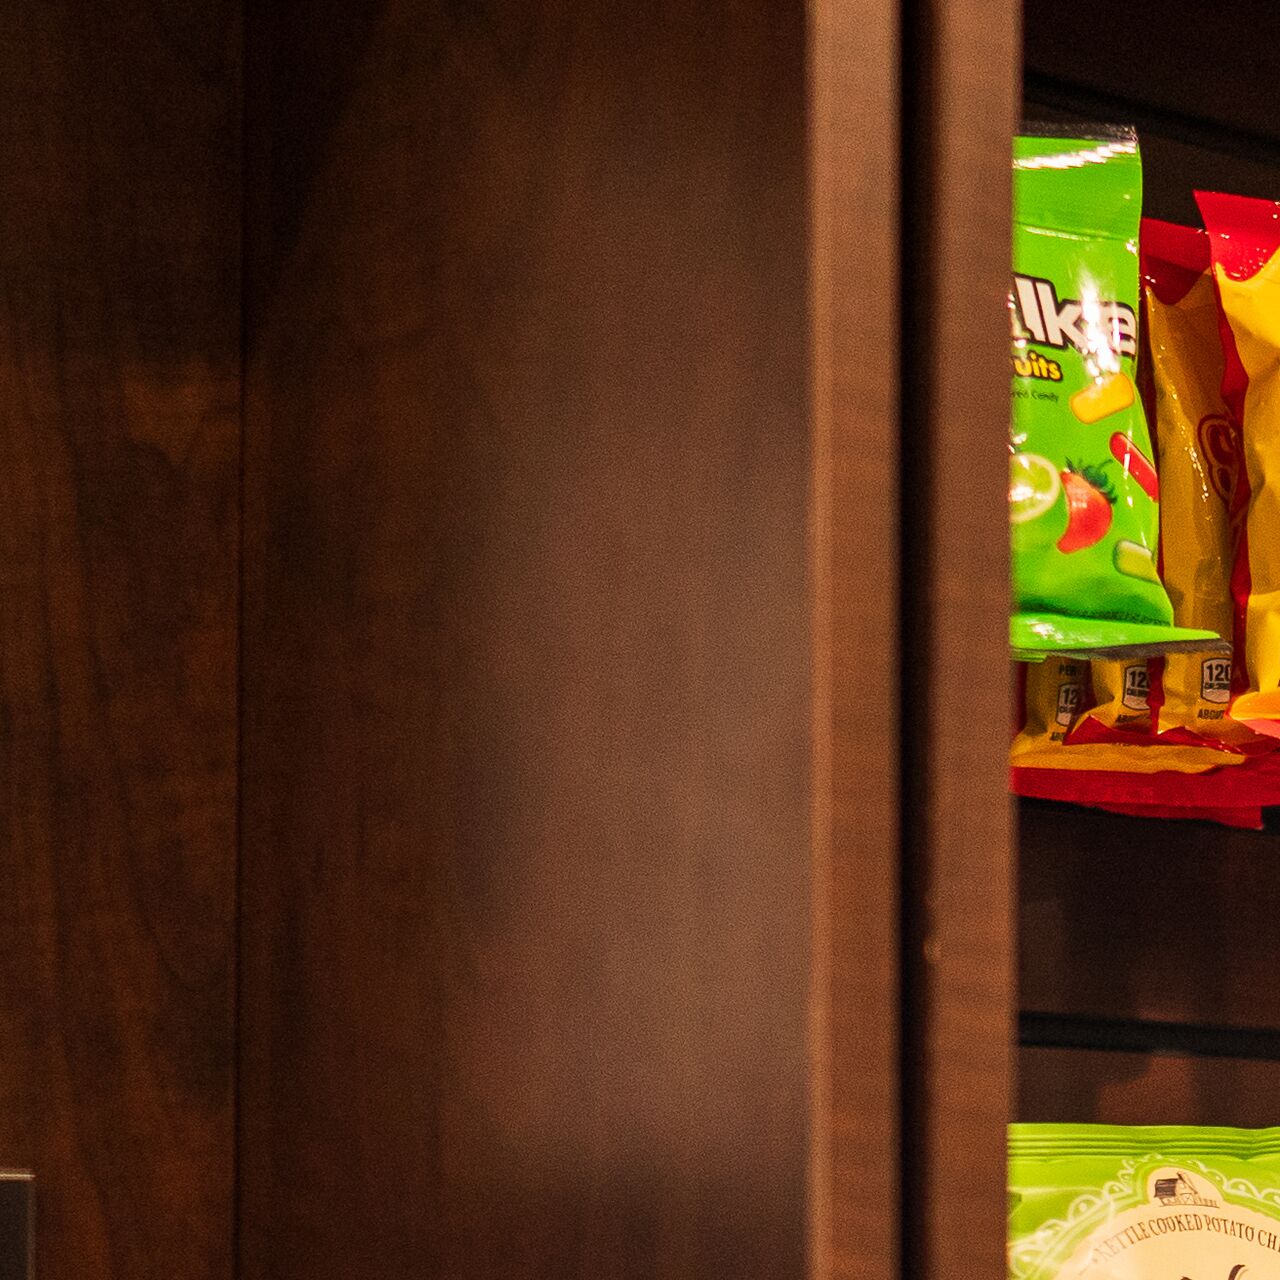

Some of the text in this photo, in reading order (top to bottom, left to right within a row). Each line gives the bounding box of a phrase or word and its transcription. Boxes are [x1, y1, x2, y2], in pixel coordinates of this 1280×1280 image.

[1130, 671, 1150, 688] 12
[1098, 1221, 1151, 1259] KETTLE
[1148, 1213, 1204, 1237] COOKED
[1206, 1214, 1256, 1242] POTATO
